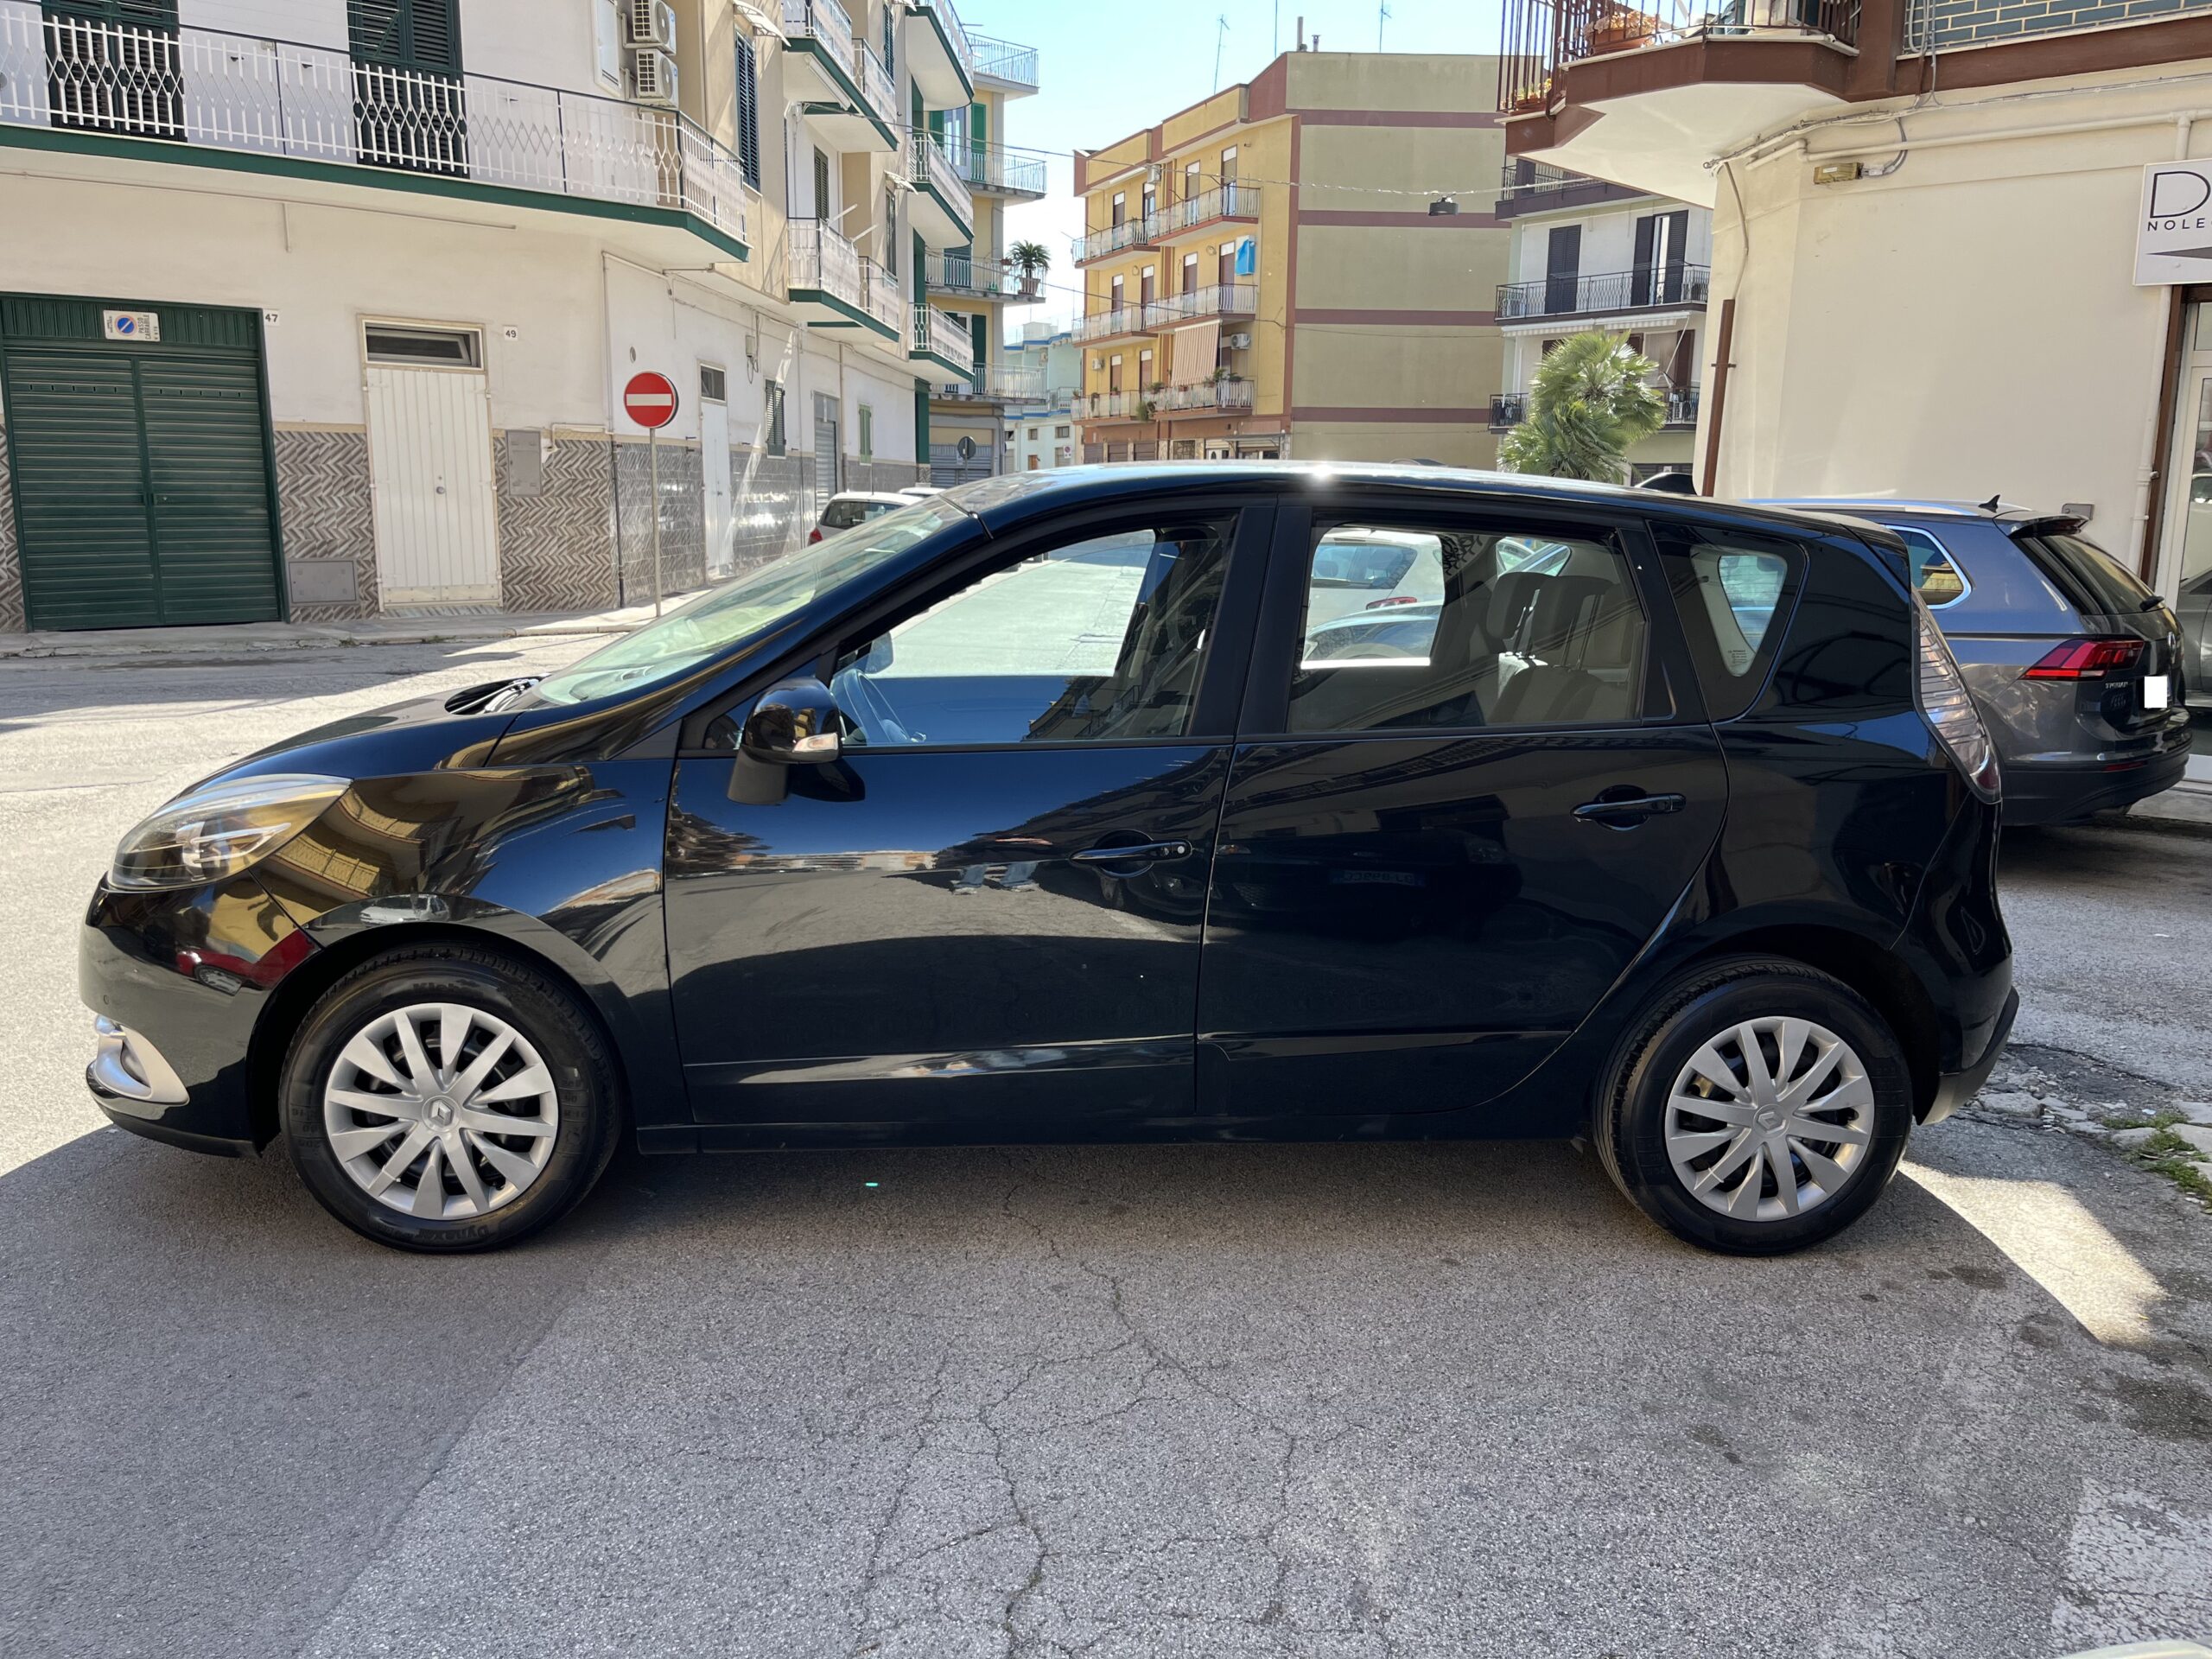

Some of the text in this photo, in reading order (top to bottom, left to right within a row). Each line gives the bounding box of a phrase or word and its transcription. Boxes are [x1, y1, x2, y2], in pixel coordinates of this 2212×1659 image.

[2150, 170, 2211, 219] D
[2147, 218, 2212, 232] NOLE
[265, 314, 278, 322] 47
[505, 329, 517, 338] 49
